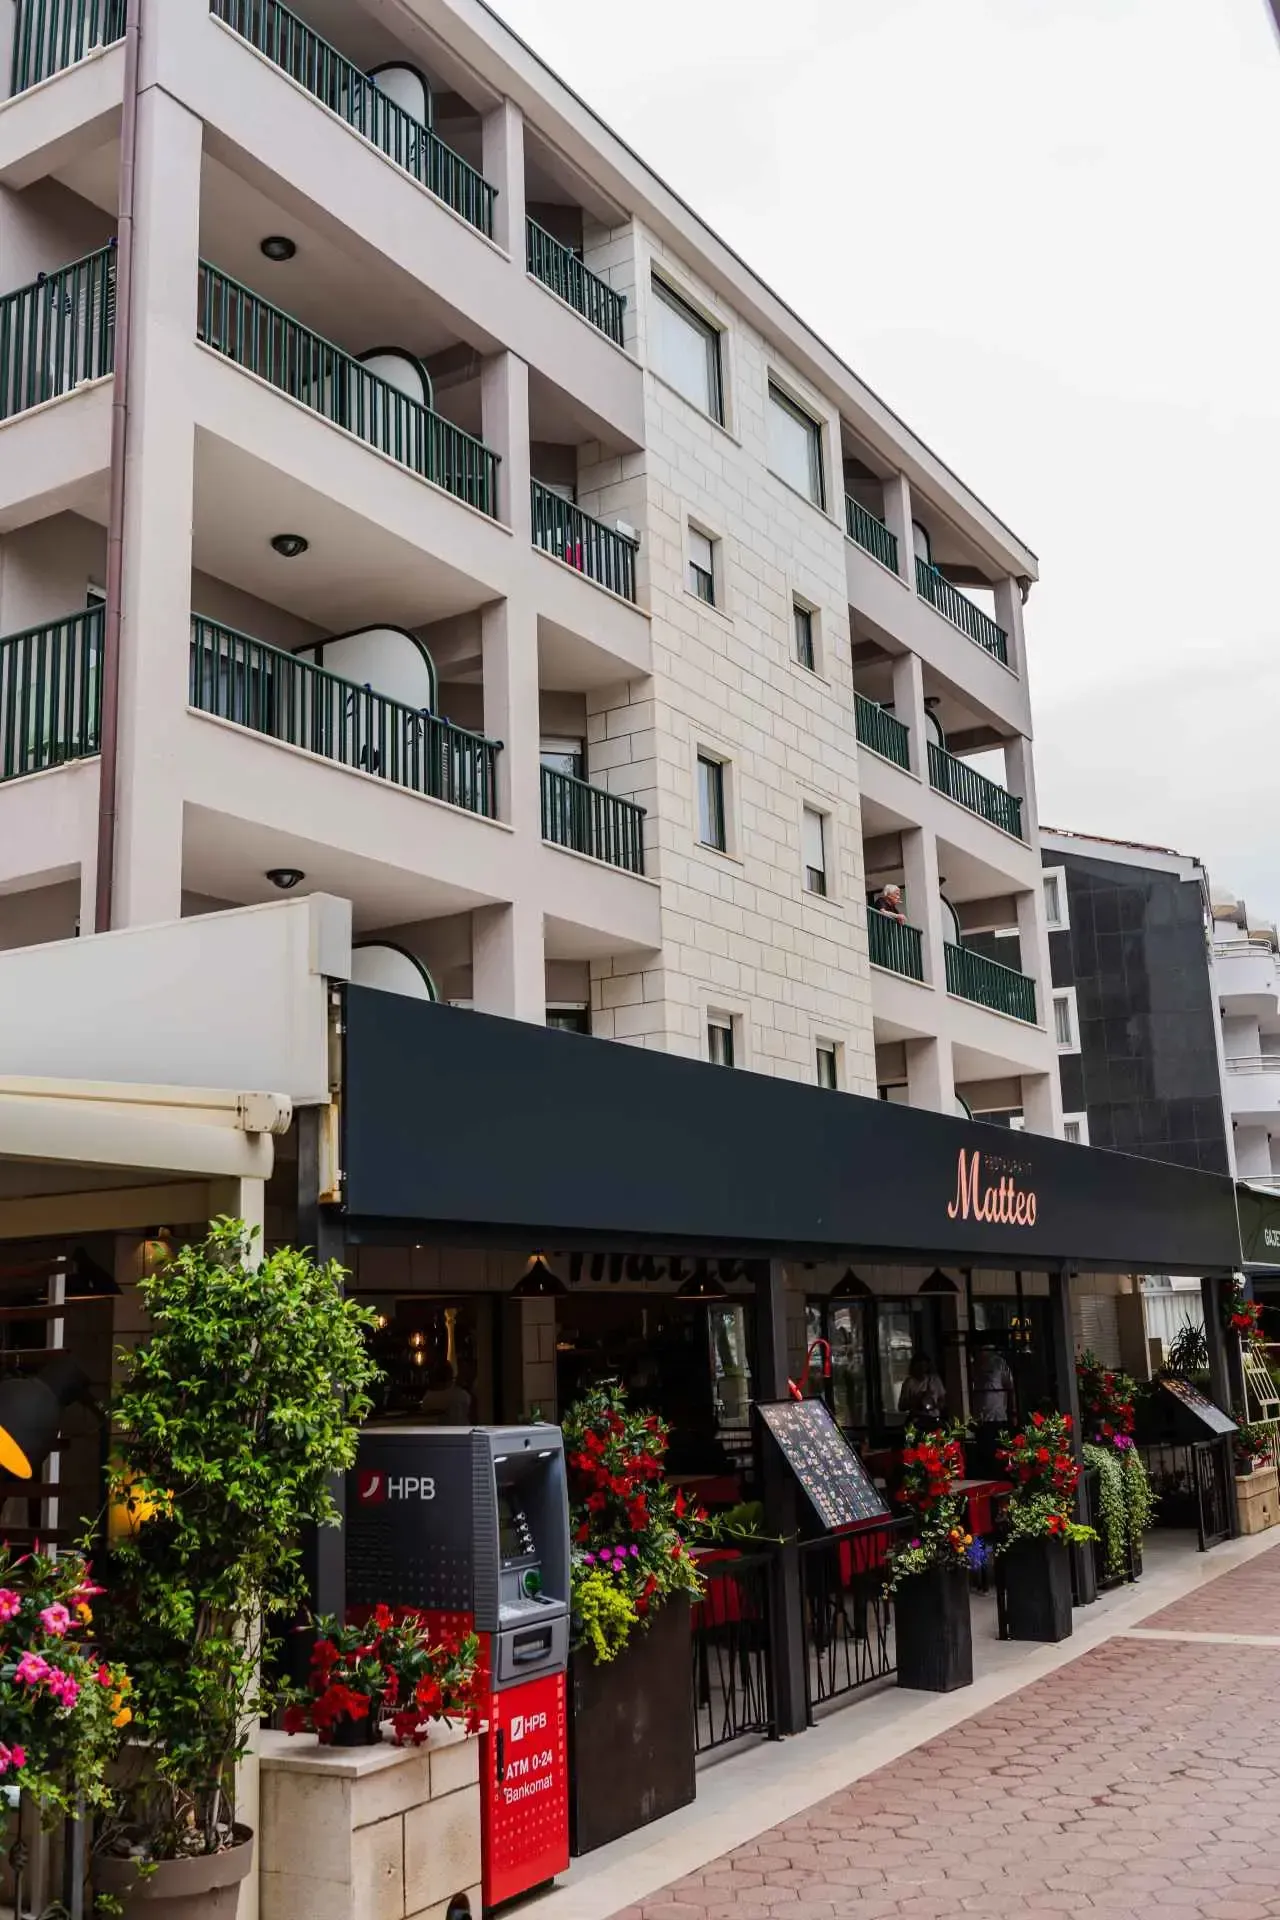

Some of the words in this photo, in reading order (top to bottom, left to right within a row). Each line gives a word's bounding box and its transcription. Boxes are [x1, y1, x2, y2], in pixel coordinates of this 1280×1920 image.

[947, 1148, 1037, 1226] Matteo
[388, 1477, 436, 1500] HPB
[525, 1712, 547, 1733] HPB
[506, 1757, 530, 1781] ATM
[532, 1749, 553, 1770] 0-24
[505, 1774, 553, 1804] Bankomat
